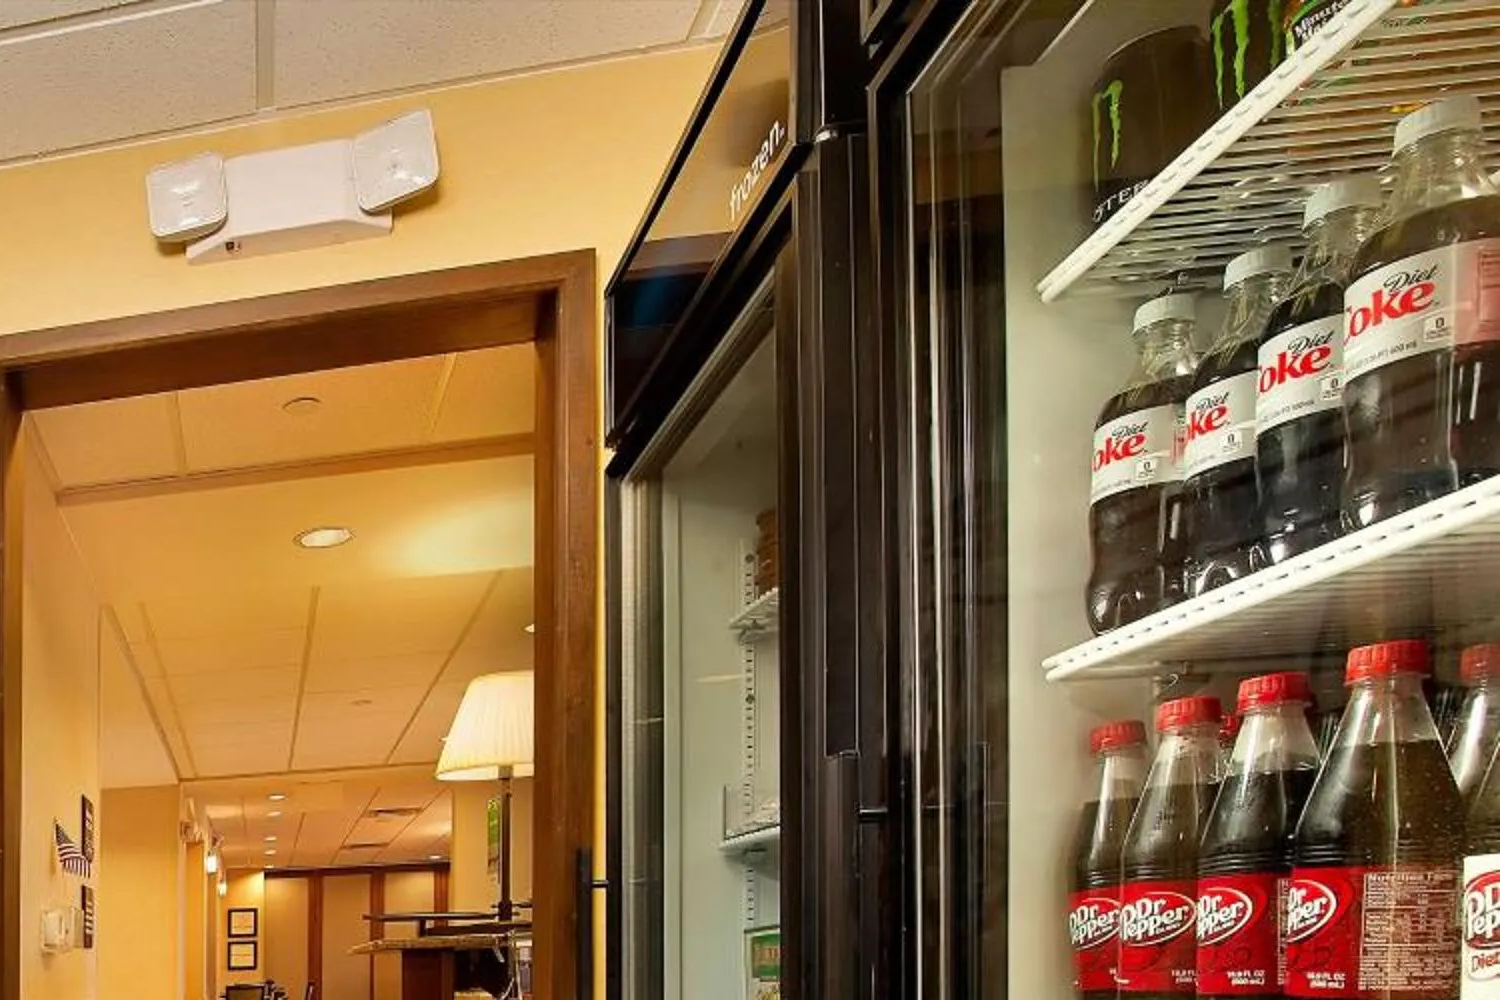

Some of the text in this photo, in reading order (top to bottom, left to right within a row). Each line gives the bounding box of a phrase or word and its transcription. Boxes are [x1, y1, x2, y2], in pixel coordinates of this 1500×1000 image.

[1384, 265, 1439, 292] Diet
[1288, 331, 1335, 353] Diet
[1259, 345, 1332, 393] oke
[1092, 432, 1146, 471] oke
[1077, 904, 1098, 924] Dr
[1135, 897, 1167, 921] Dr
[1120, 905, 1189, 941] Pepper
